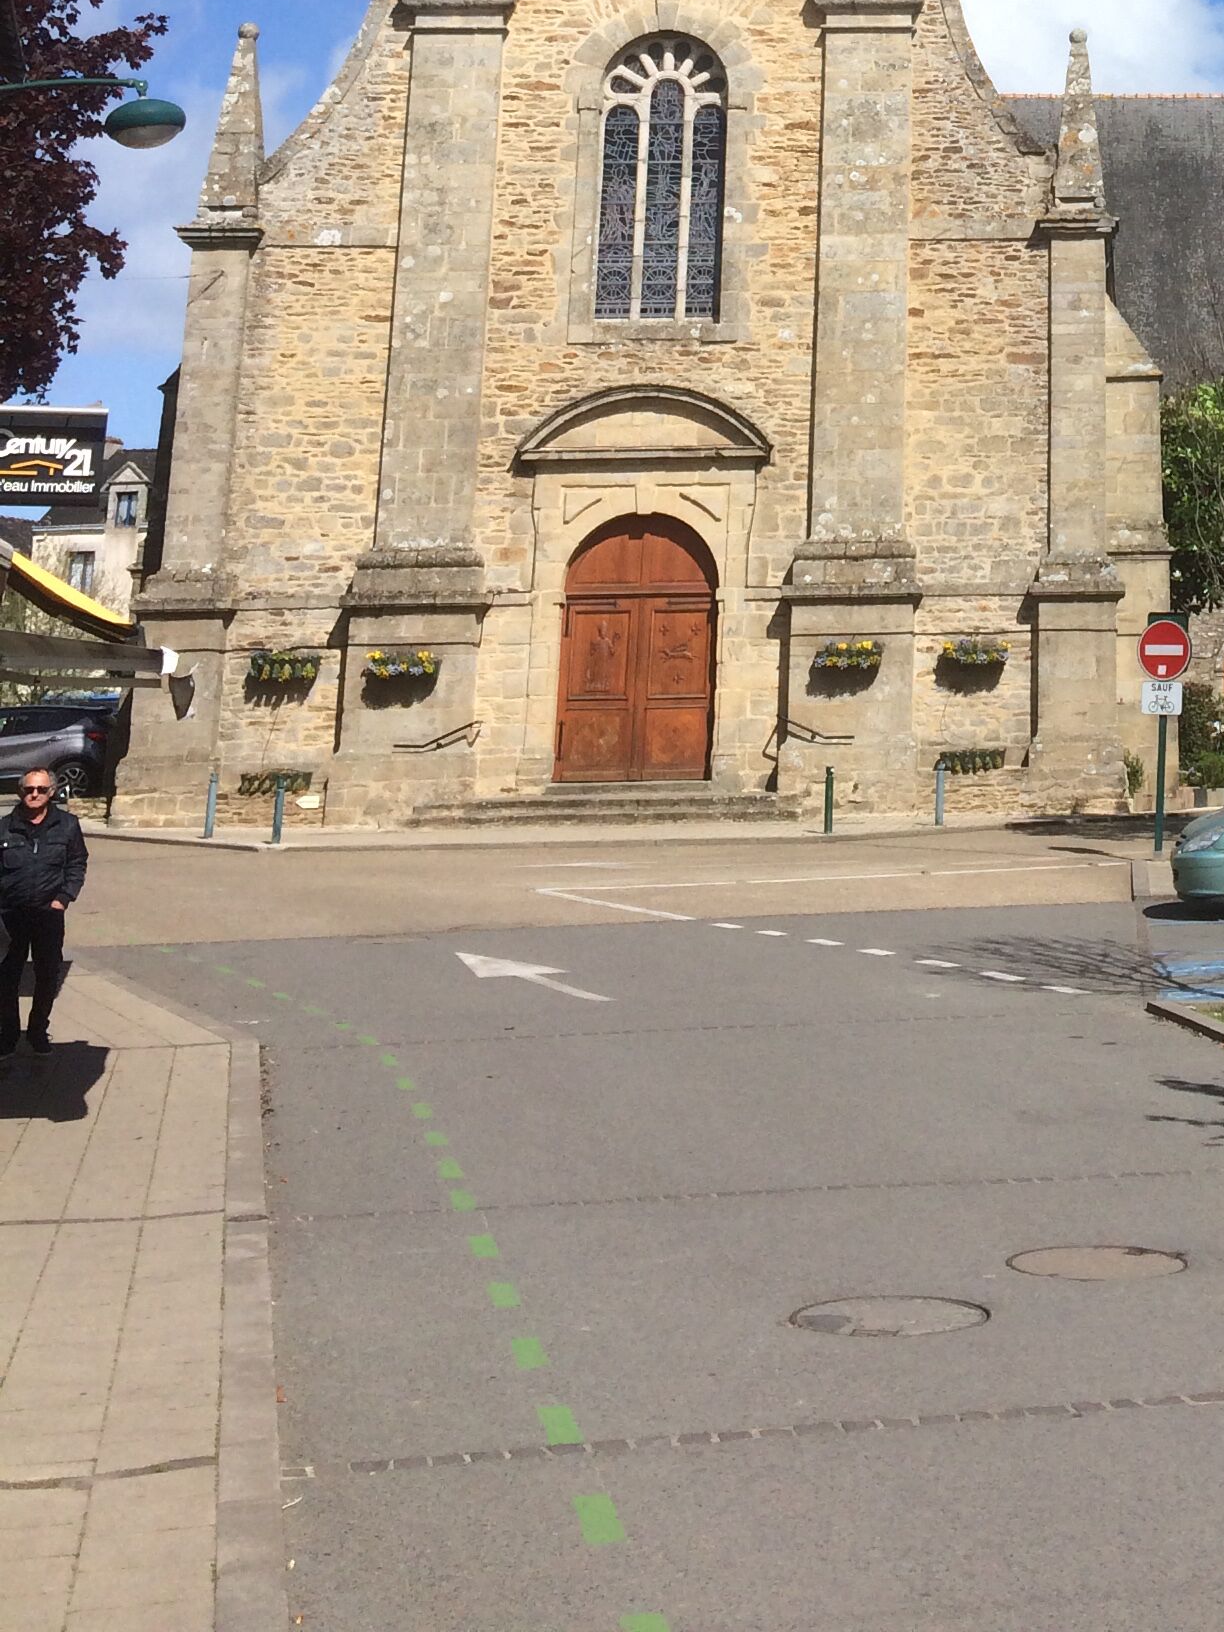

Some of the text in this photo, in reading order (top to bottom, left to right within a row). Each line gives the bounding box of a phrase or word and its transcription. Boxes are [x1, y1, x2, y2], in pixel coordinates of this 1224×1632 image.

[63, 449, 93, 477] 21
[0, 479, 95, 493] 'eau Immobilier
[1151, 683, 1174, 692] SAUF
